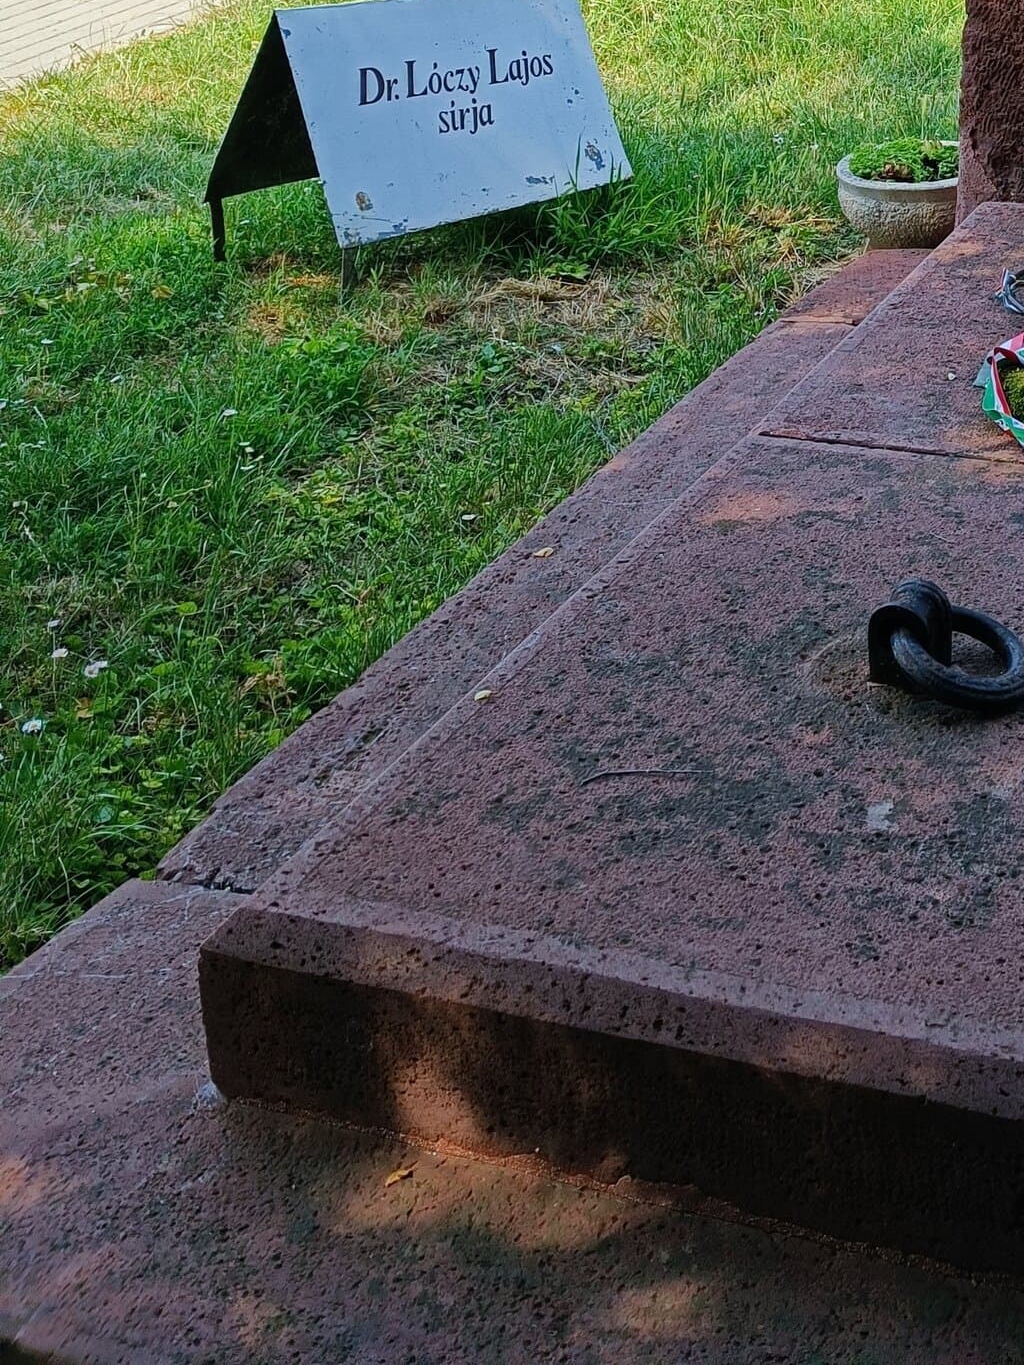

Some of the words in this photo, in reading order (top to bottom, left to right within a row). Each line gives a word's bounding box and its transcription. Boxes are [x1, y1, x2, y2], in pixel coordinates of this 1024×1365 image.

[358, 66, 400, 106] Dr.
[404, 60, 481, 99] Lóczy
[486, 48, 554, 87] Lajos
